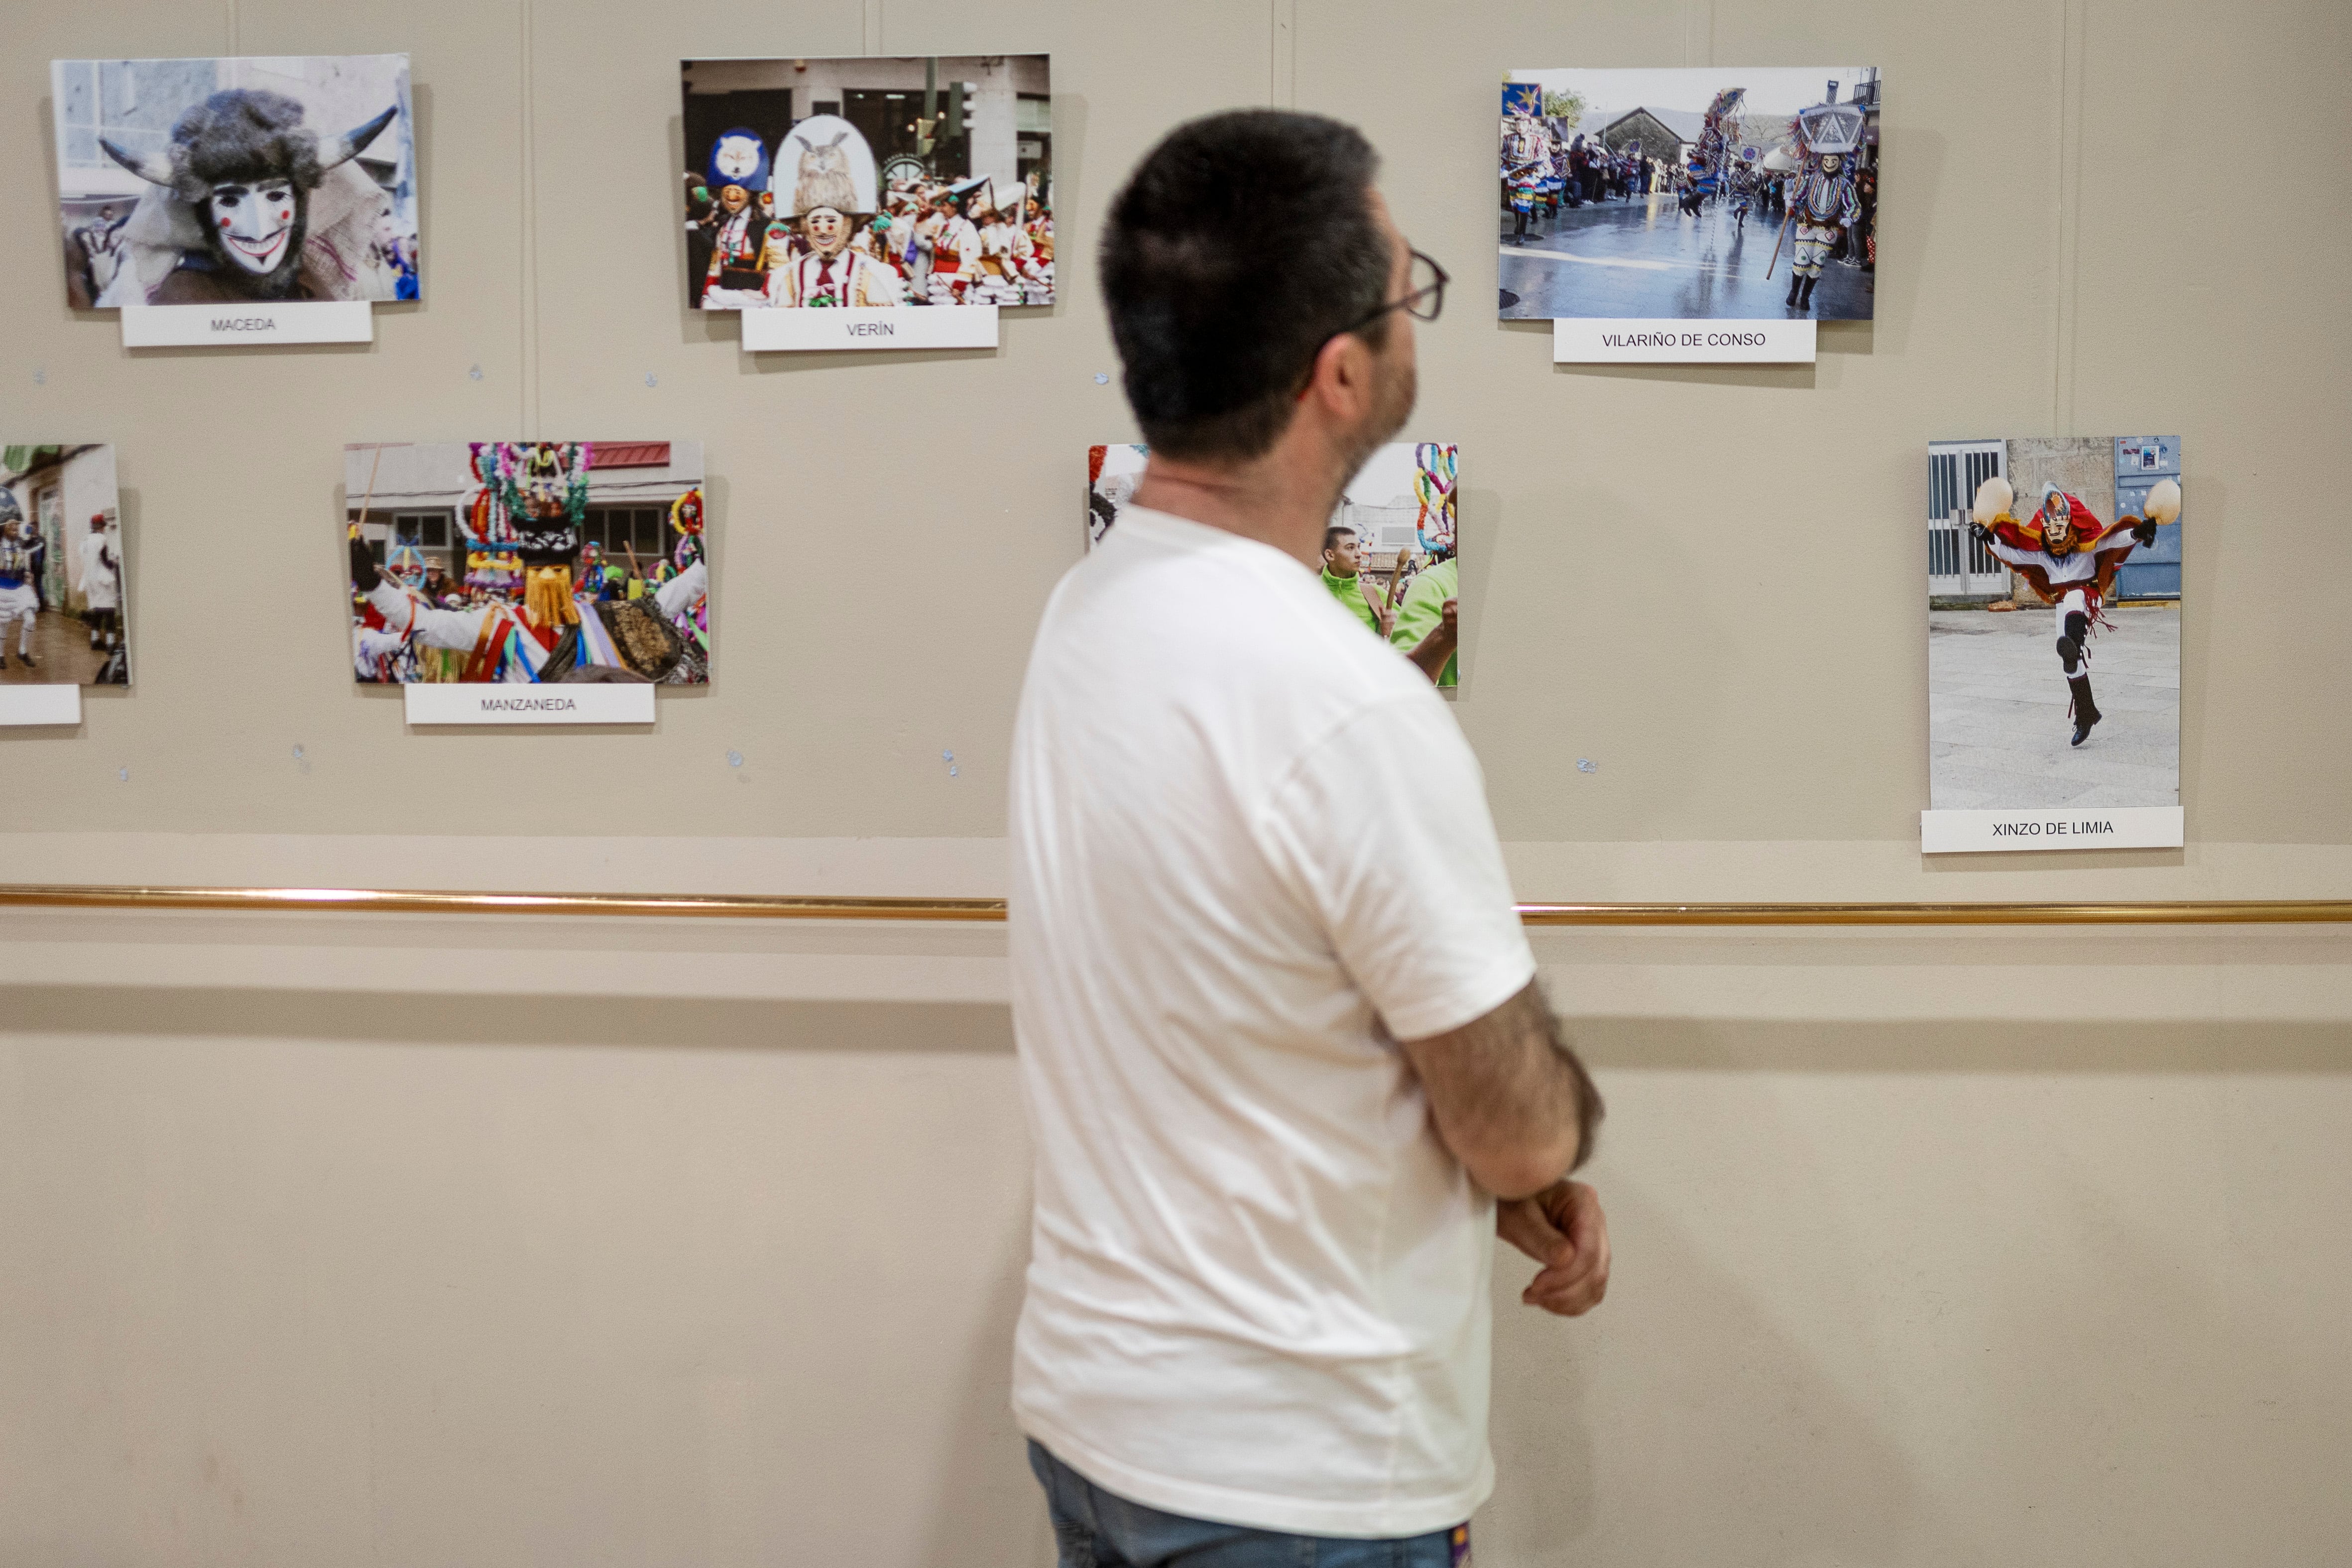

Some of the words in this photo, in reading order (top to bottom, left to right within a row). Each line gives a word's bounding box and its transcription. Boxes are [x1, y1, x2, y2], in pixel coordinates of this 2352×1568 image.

[211, 318, 276, 331] MACEDA
[1602, 332, 1676, 347] VILARIÑO
[1681, 334, 1702, 346] DE
[1708, 333, 1766, 346] CONSO
[481, 699, 576, 711] MANZANEDA
[1993, 823, 2041, 836] XINZO
[2046, 822, 2067, 835] DE
[2072, 821, 2114, 834] LIMIA
